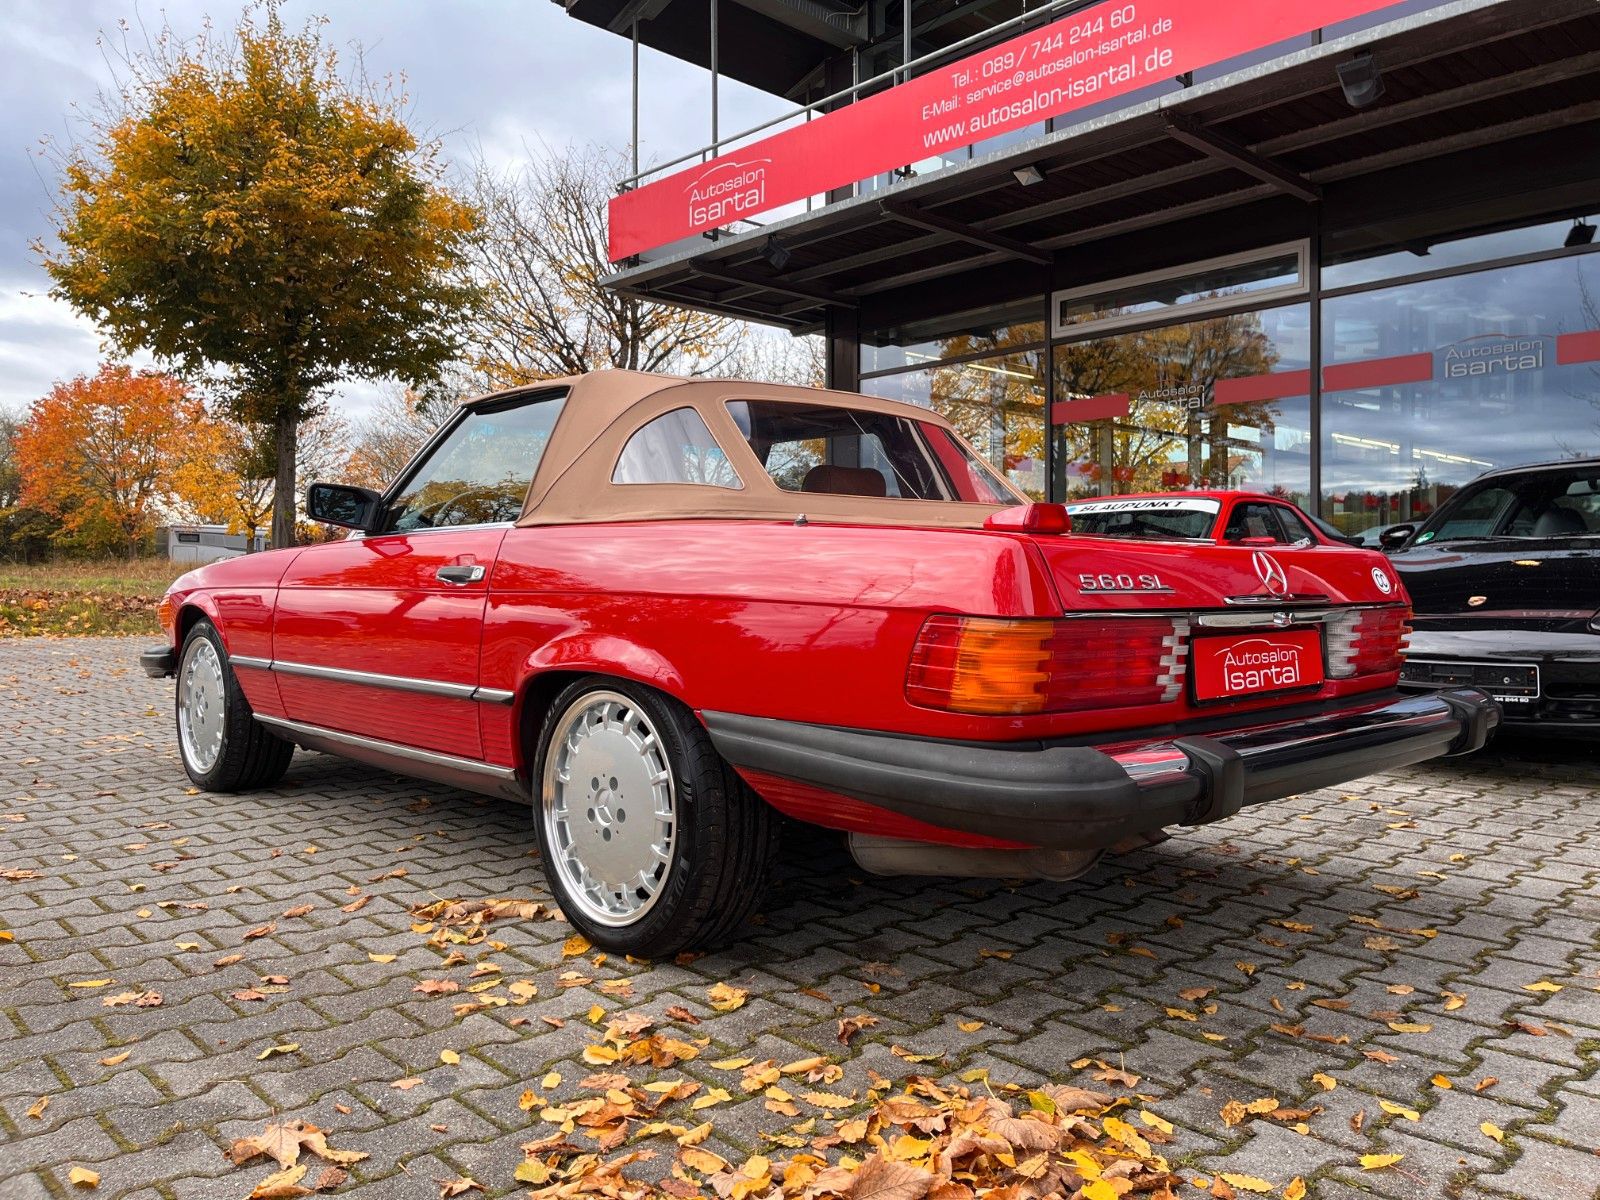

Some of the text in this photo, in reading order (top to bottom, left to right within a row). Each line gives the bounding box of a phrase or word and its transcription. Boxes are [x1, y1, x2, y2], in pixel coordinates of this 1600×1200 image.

[952, 69, 979, 89] Tel.:
[982, 53, 1014, 79] 089
[1031, 33, 1063, 59] 744
[1069, 16, 1103, 45] 244
[1110, 4, 1136, 29] 60
[922, 17, 1173, 121] E-Mail: service@autosalon-isartal.de
[923, 47, 1173, 149] www.autosalon-isartal.de
[690, 168, 765, 204] Autosalon
[689, 179, 765, 227] Isartal
[1445, 349, 1543, 378] Isartal
[1446, 340, 1543, 359] Autosalon
[1139, 384, 1205, 400] Autosalon
[1080, 500, 1187, 513] BLAUPUNKT
[1079, 574, 1170, 590] 560 SL
[1224, 648, 1298, 667] Autosalon
[1224, 659, 1300, 691] Isartal
